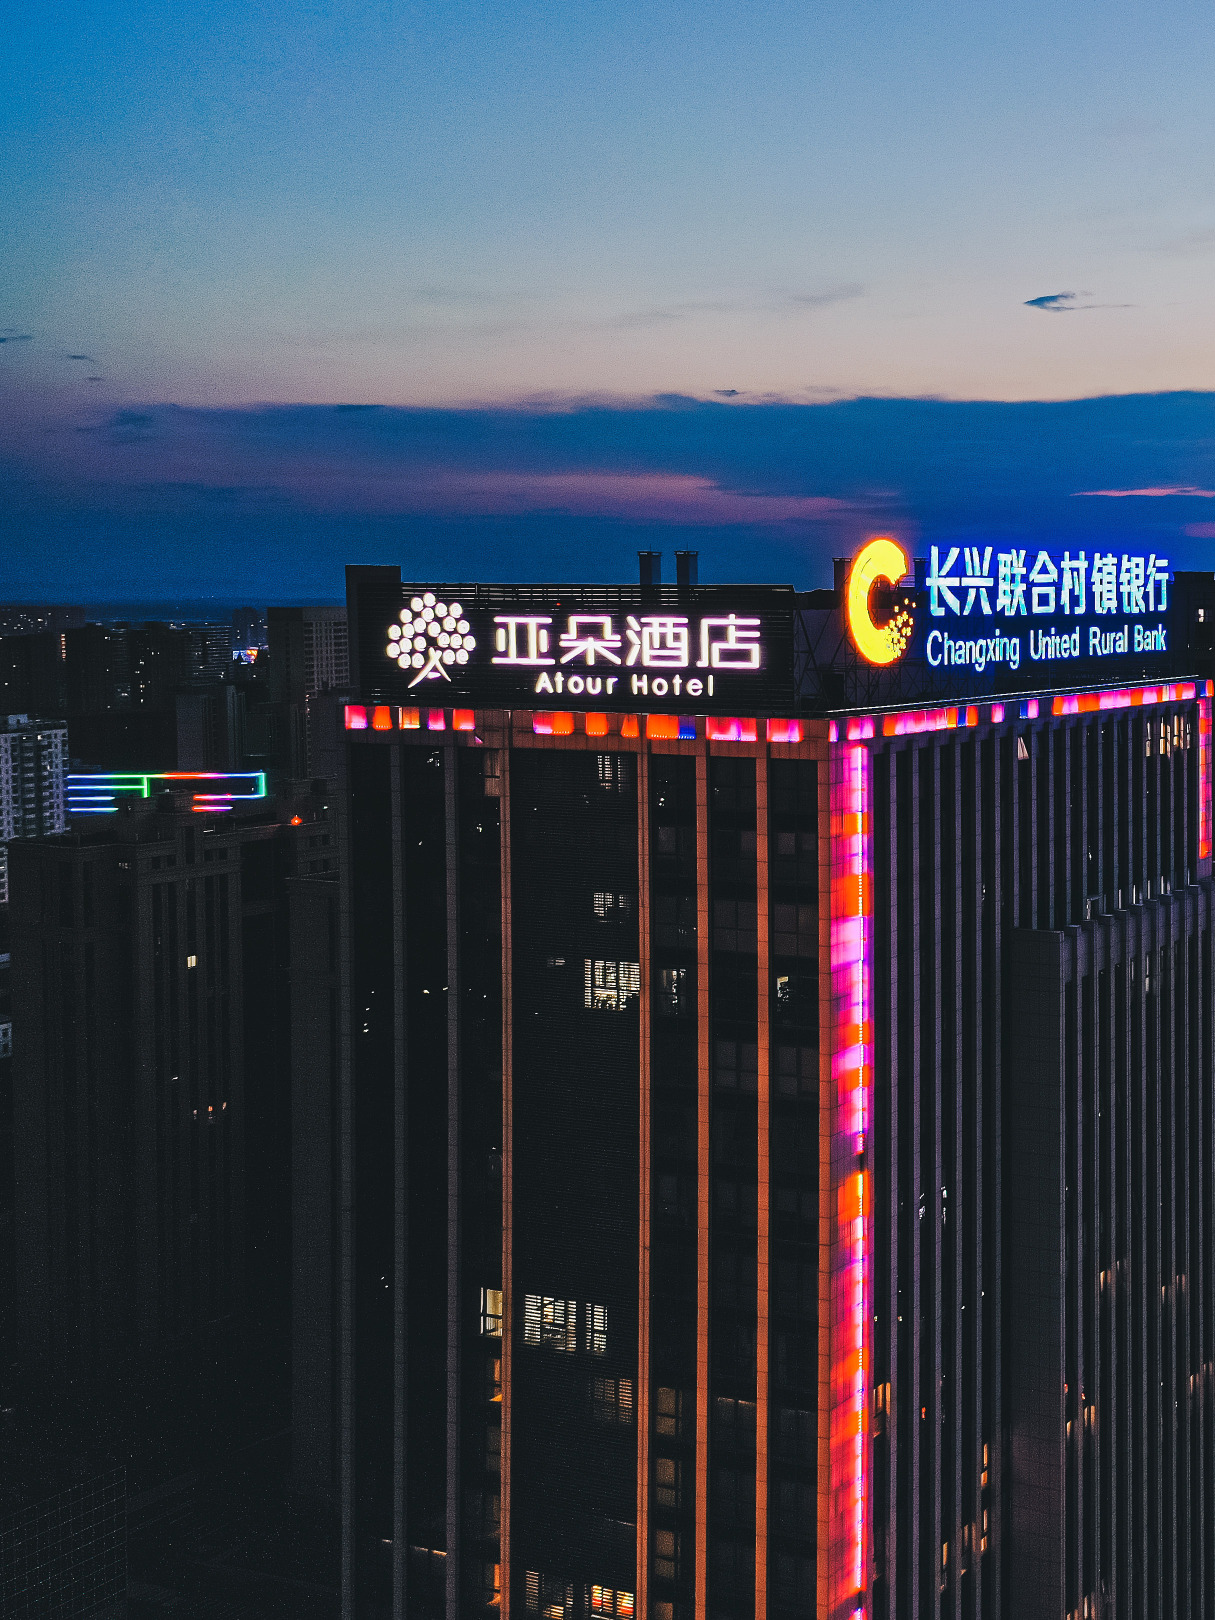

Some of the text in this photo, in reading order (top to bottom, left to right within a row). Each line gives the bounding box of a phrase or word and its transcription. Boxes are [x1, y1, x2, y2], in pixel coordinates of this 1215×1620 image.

[925, 545, 1170, 617] 长兴联合村镇银行
[490, 613, 761, 669] 亚朵酒店
[926, 623, 1168, 672] Changxing United Rural Bank
[534, 671, 715, 697] Atour Hotel
